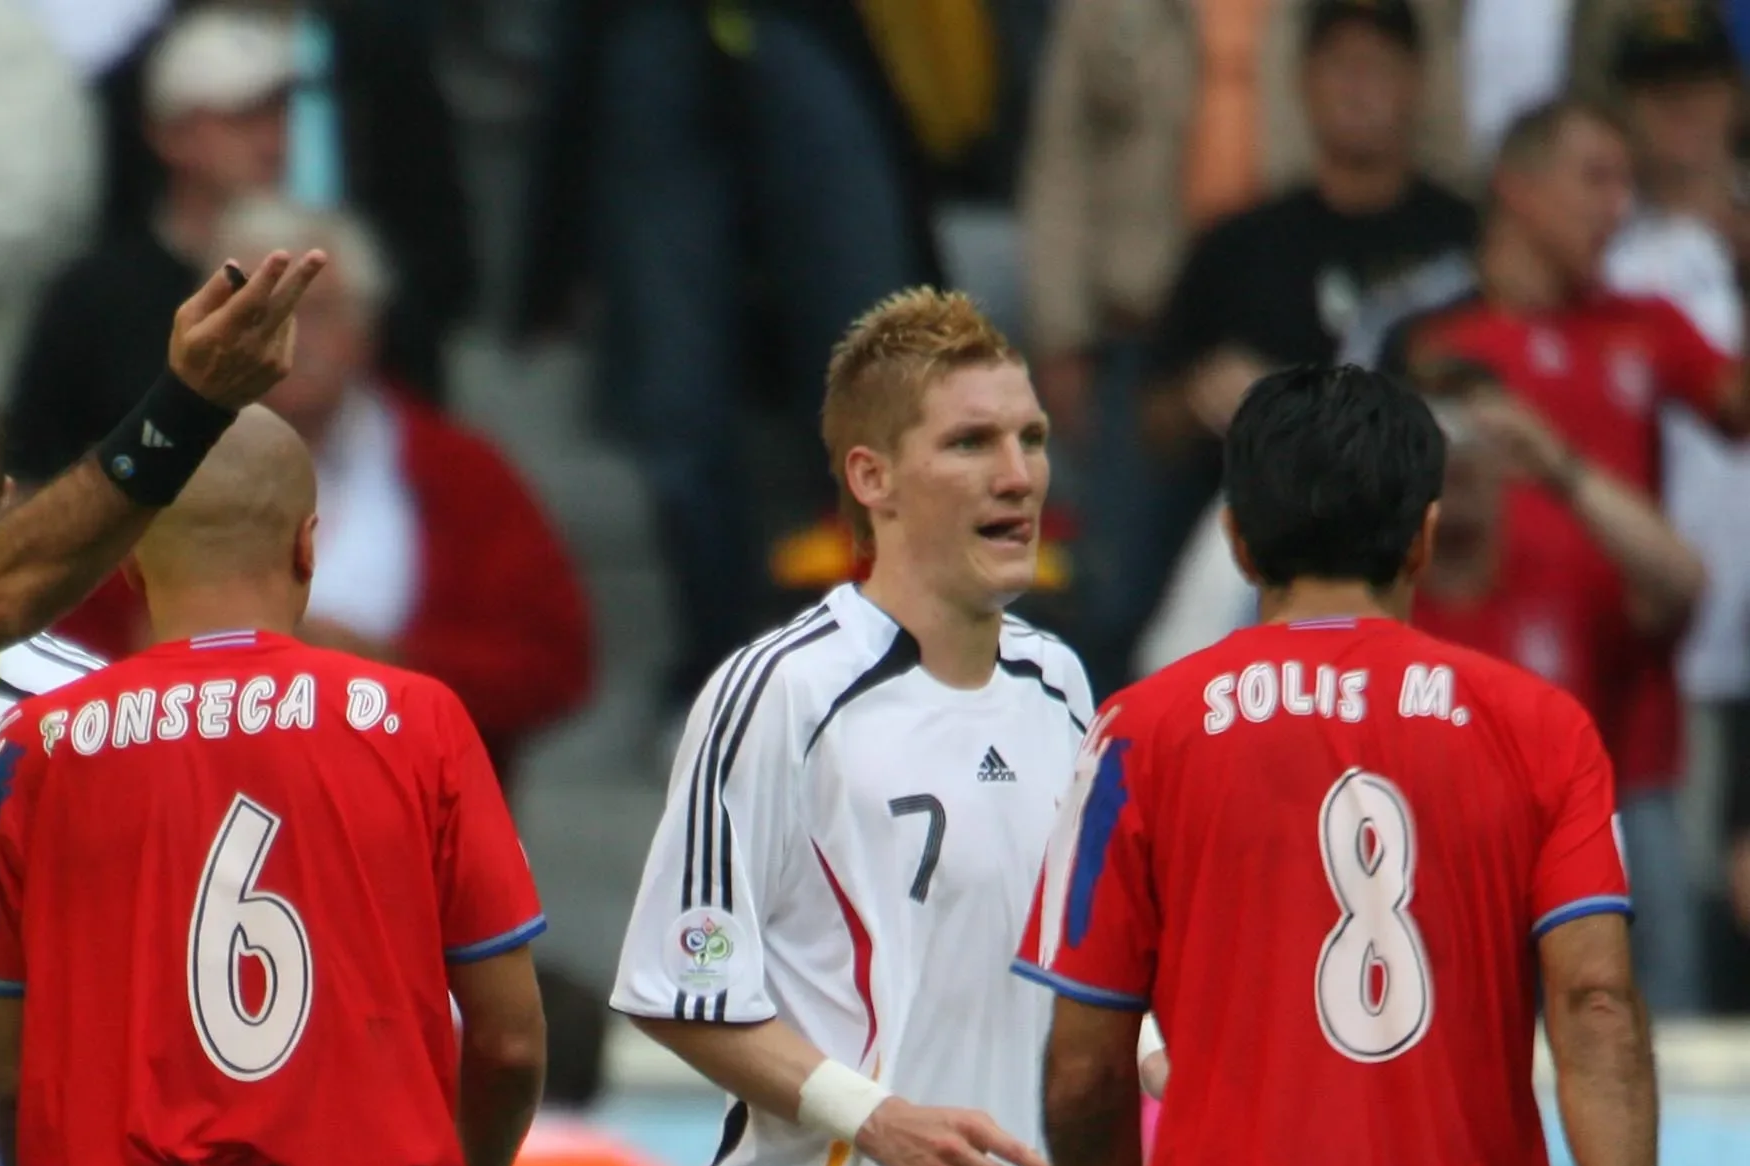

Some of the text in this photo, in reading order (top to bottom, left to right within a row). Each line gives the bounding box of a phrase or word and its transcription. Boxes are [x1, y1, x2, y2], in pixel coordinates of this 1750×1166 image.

[40, 674, 401, 757] FONSECA D.
[1203, 660, 1471, 736] SOLIS M.
[976, 770, 1017, 783] adidas
[887, 793, 947, 905] 7
[187, 791, 313, 1082] 6
[1315, 766, 1434, 1064] 8
